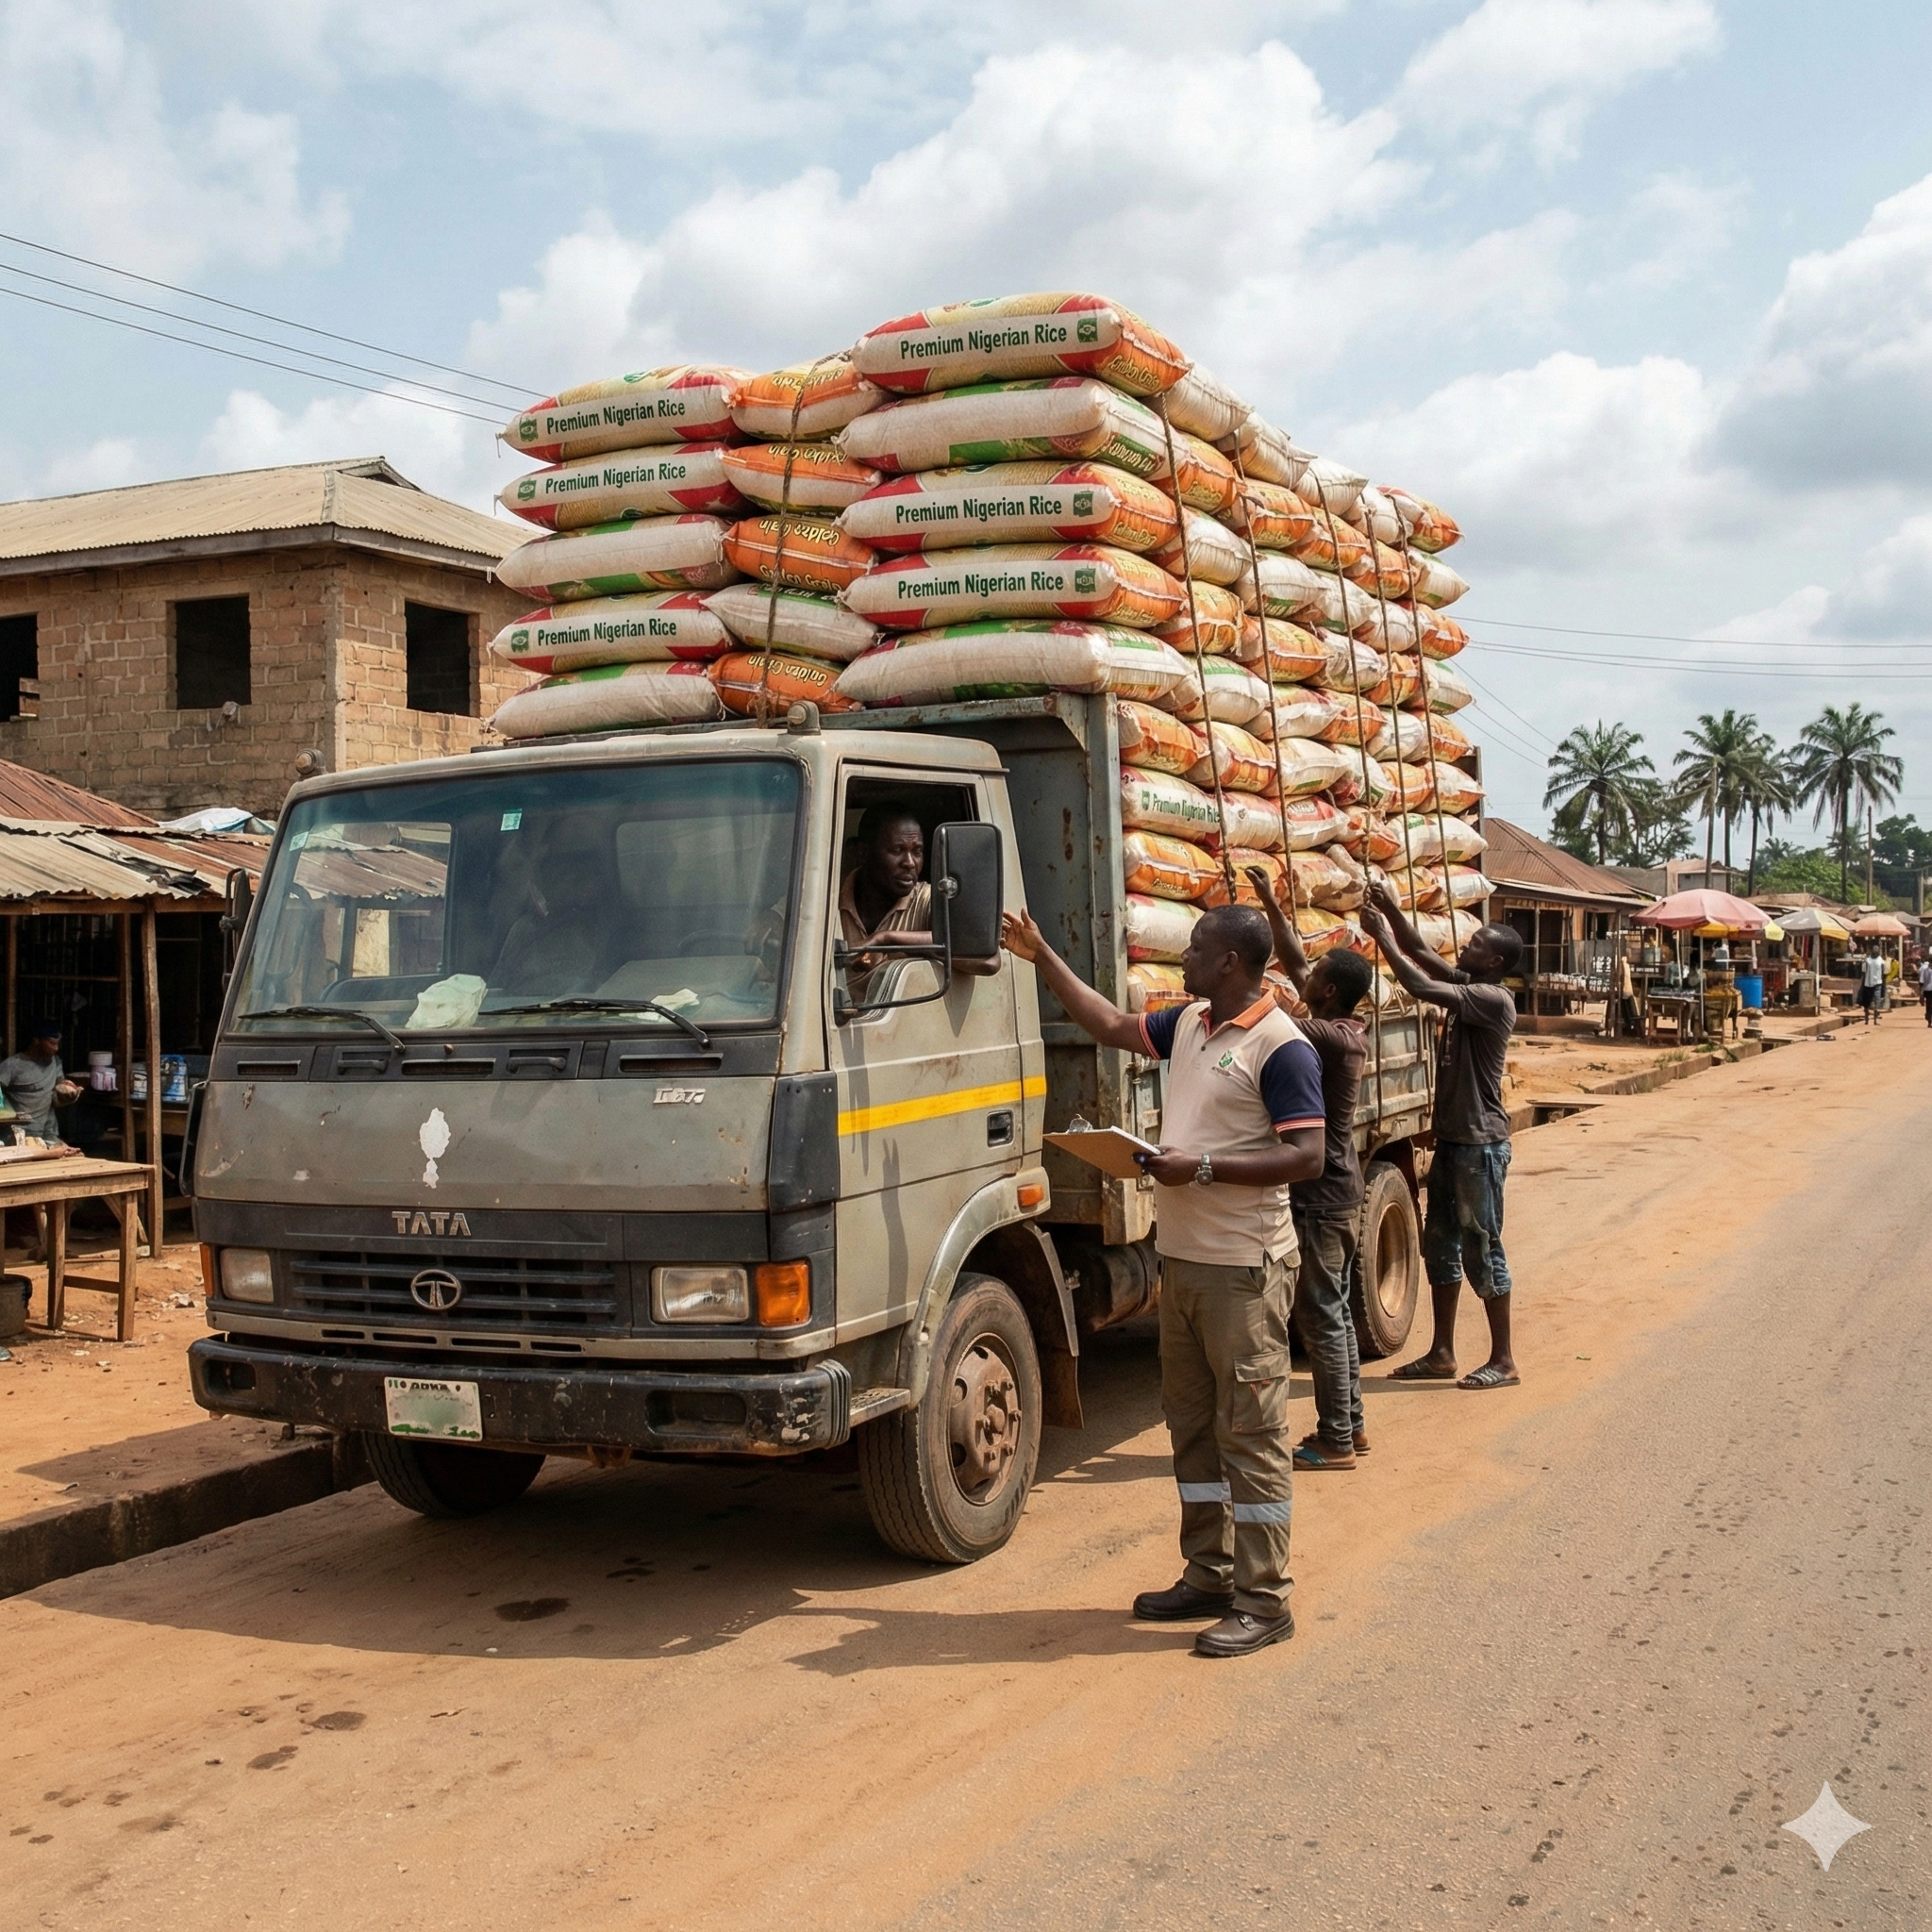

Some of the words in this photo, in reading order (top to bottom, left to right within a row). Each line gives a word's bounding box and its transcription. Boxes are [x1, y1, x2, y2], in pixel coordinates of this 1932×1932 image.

[900, 334, 964, 360] Premium
[968, 325, 1029, 354] Nigerian
[1034, 324, 1067, 342] Rice
[546, 409, 600, 435] Premium
[603, 401, 655, 429] Nigerian
[658, 399, 685, 418] Rice
[544, 472, 599, 494] Premium
[603, 463, 655, 490] Nigerian
[658, 462, 686, 480] Rice
[895, 503, 958, 525] Premium
[962, 497, 1024, 522] Nigerian
[1029, 495, 1062, 515] Rice
[897, 578, 960, 600] Premium
[964, 573, 1025, 598] Nigerian
[1030, 571, 1064, 591] Rice
[537, 626, 591, 646] Premium
[593, 620, 645, 643] Nigerian
[648, 618, 676, 636] Rice
[391, 1211, 472, 1237] TATA
